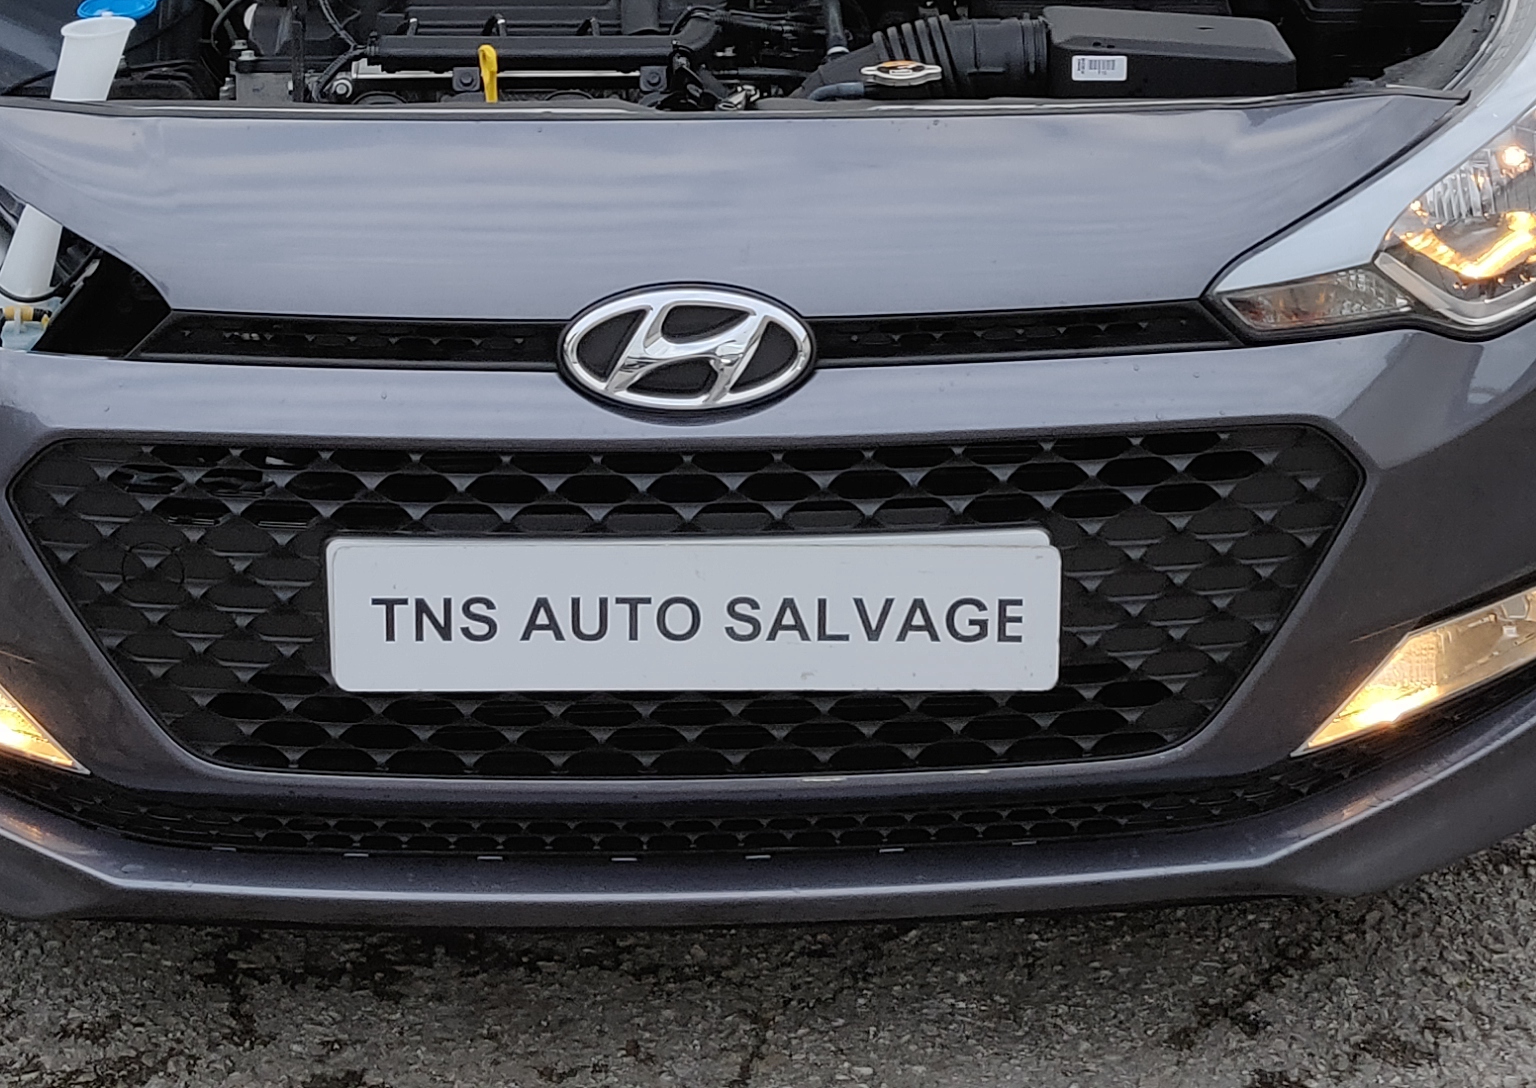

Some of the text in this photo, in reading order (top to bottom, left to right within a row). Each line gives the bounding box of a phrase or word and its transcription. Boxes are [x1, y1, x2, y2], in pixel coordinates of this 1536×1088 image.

[371, 596, 1023, 643] TNS AUTO SALVAGE
